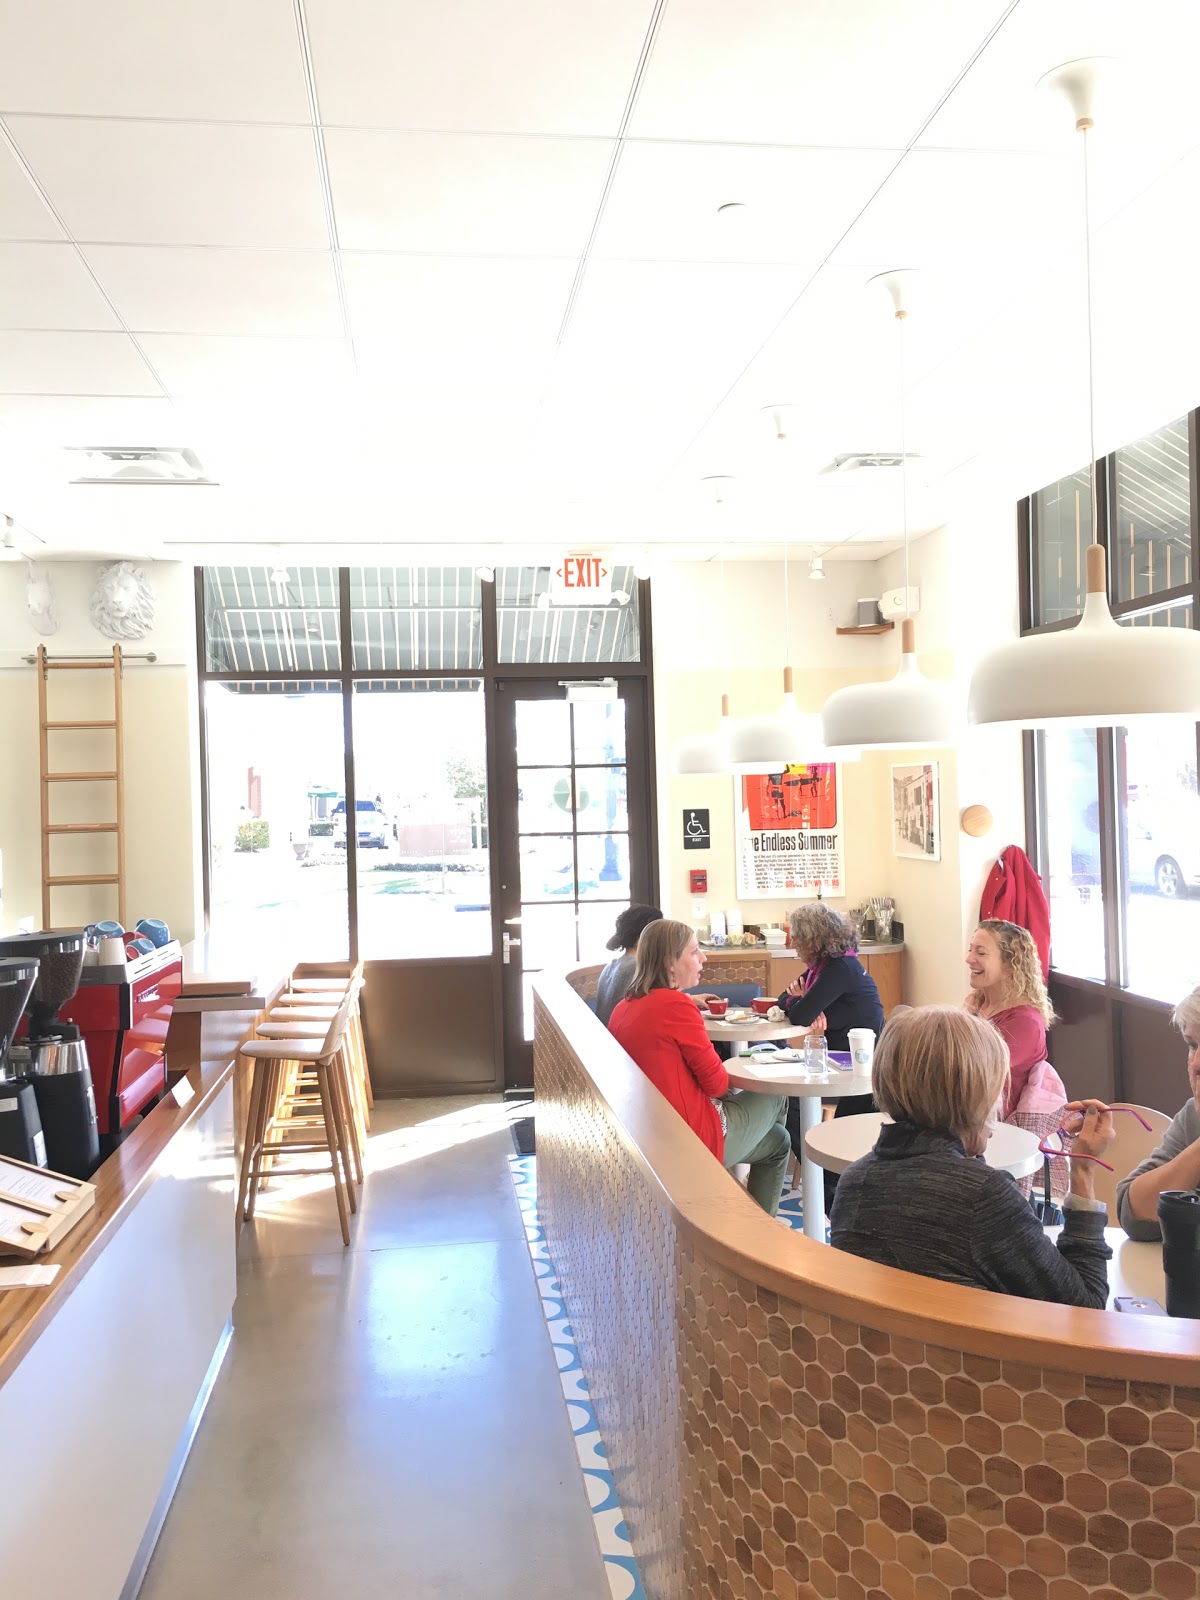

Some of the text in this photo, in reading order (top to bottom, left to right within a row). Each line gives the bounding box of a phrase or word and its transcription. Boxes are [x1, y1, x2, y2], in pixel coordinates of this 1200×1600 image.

[564, 558, 602, 587] EXIT
[761, 832, 796, 851] Endless
[798, 831, 838, 851] Summer
